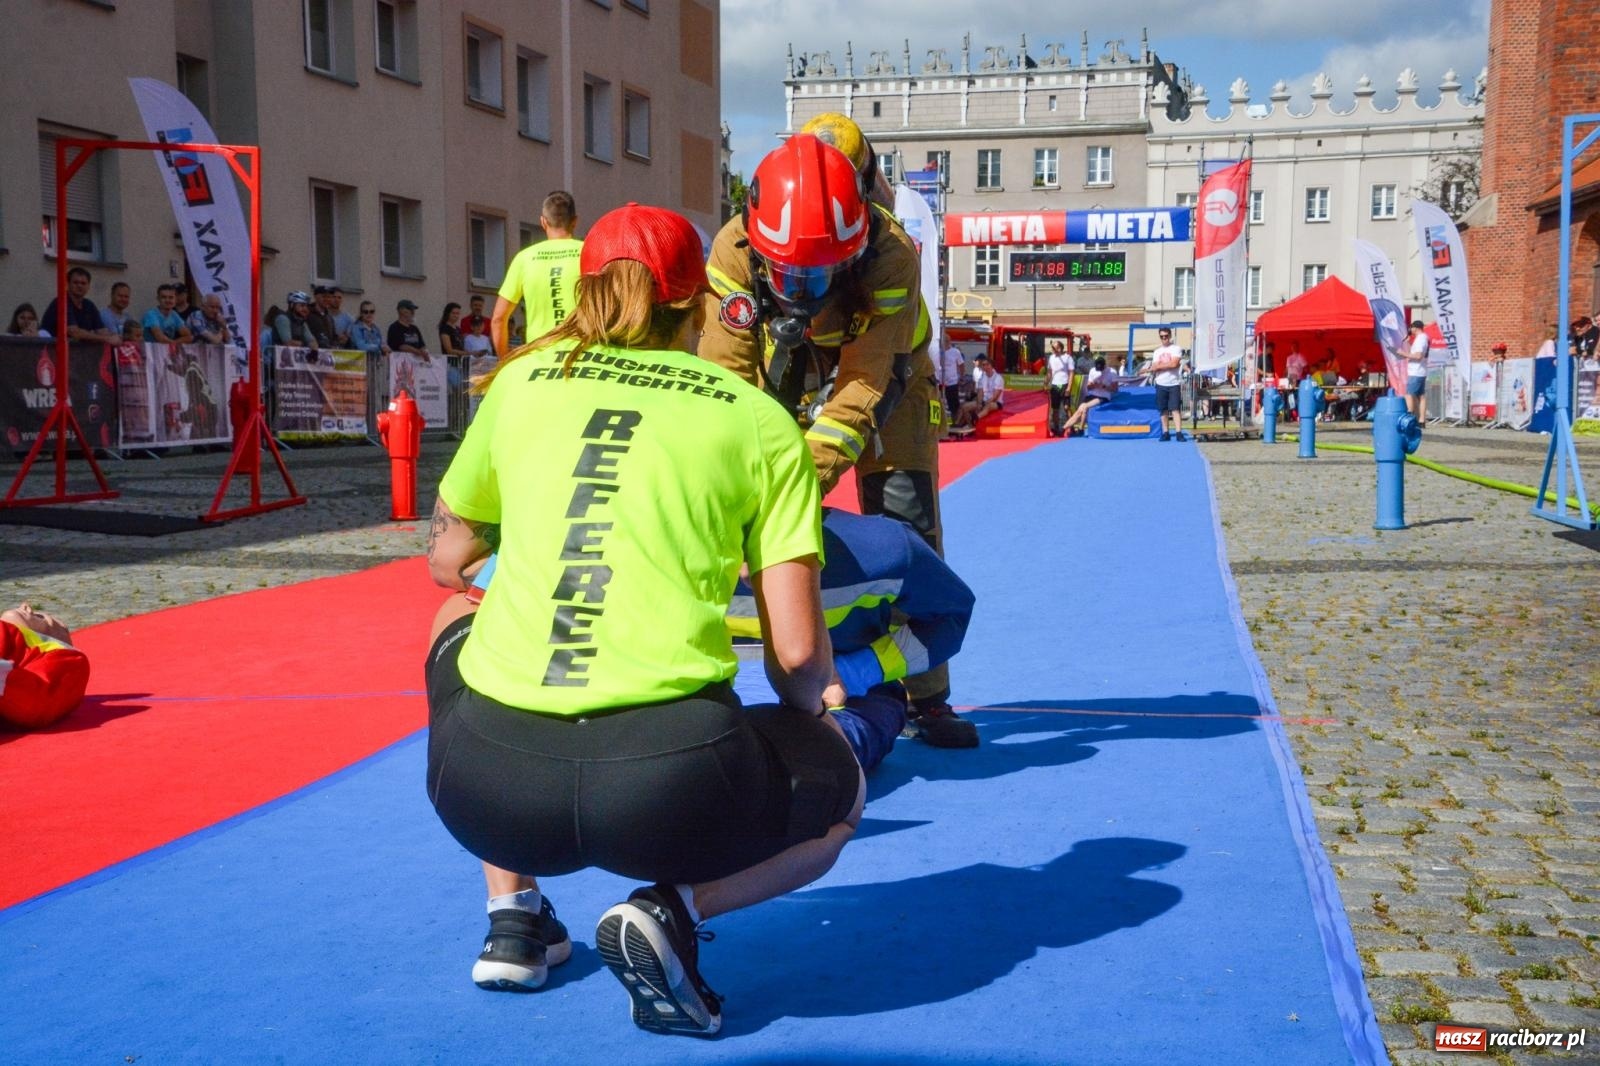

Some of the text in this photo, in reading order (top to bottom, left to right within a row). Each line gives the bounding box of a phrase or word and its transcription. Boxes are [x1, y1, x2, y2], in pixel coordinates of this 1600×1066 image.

[961, 211, 1175, 243] META META
[1013, 262, 1123, 276] 3:17.88 3:17.88
[549, 267, 565, 327] REFER
[1214, 258, 1226, 359] VANESSA
[527, 366, 738, 404] FIREFIGHTER
[553, 350, 724, 386] TOUGHEST
[540, 407, 644, 688] REFEREE
